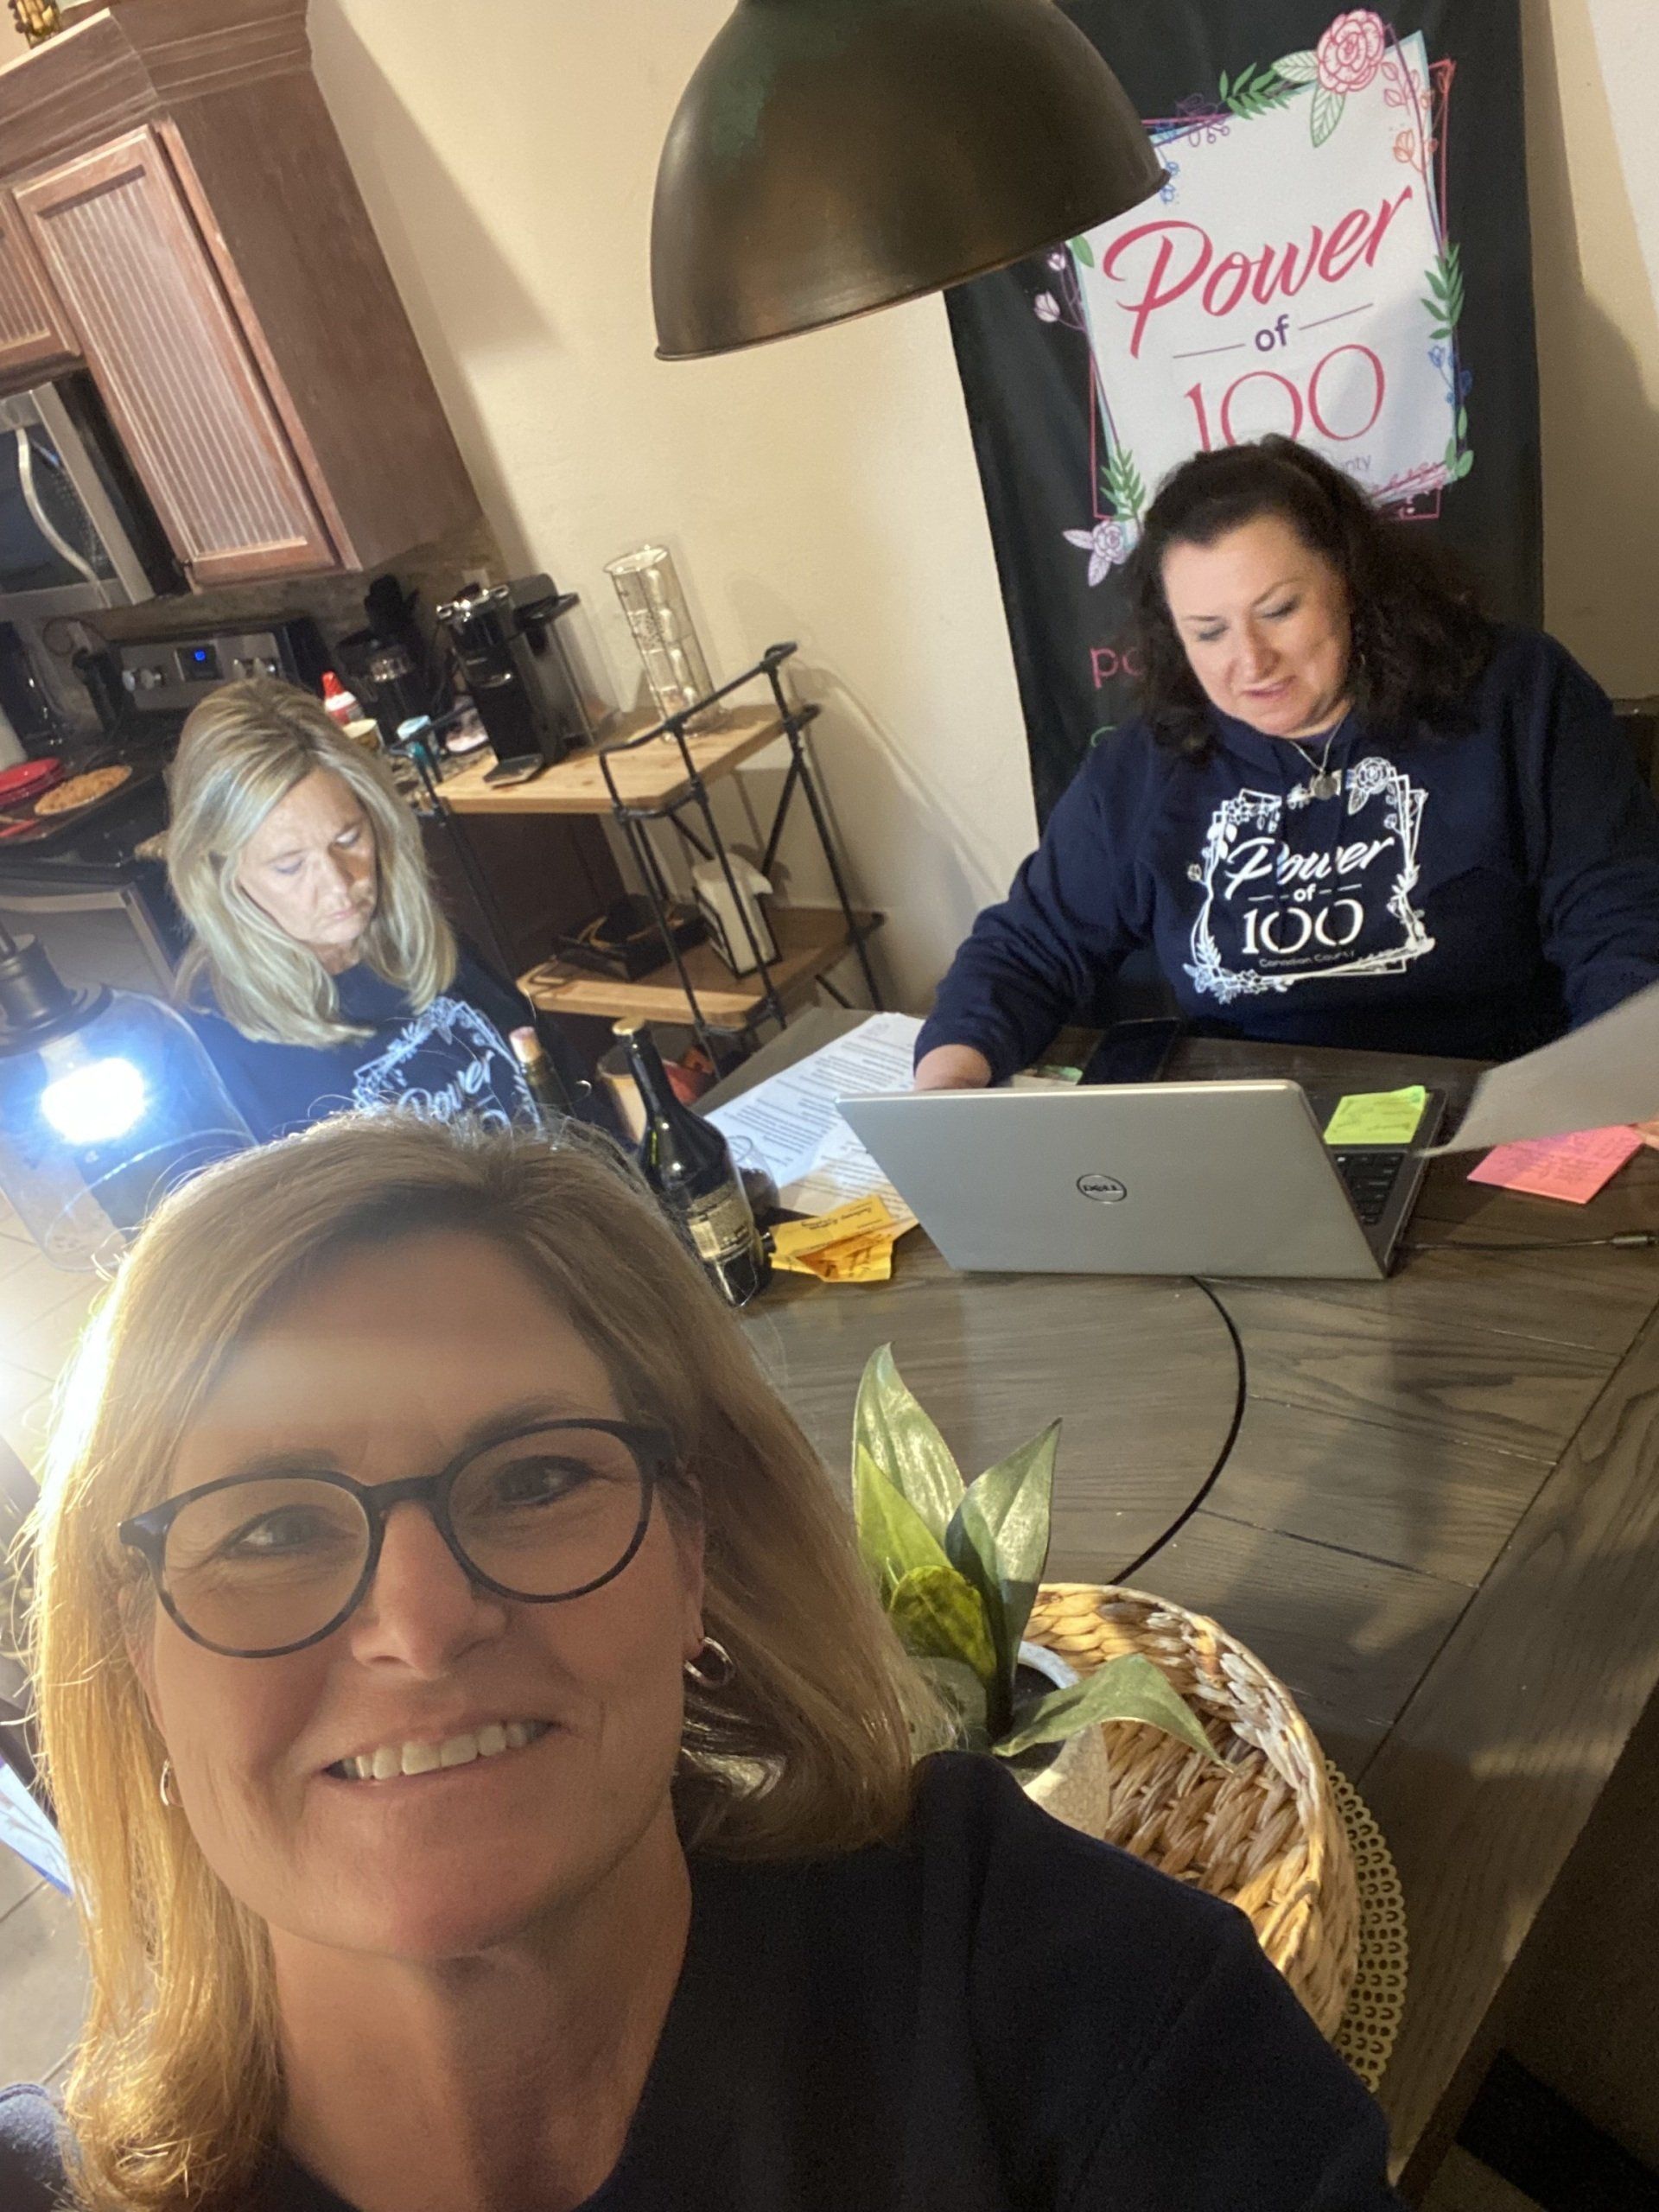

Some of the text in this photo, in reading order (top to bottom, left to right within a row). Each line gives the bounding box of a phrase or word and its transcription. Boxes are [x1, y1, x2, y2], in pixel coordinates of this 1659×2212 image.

[1103, 186, 1413, 358] Power
[1255, 314, 1290, 352] of
[1184, 343, 1385, 452] 100
[1224, 836, 1395, 900] Power
[1293, 883, 1317, 902] of
[1242, 898, 1364, 955] 100
